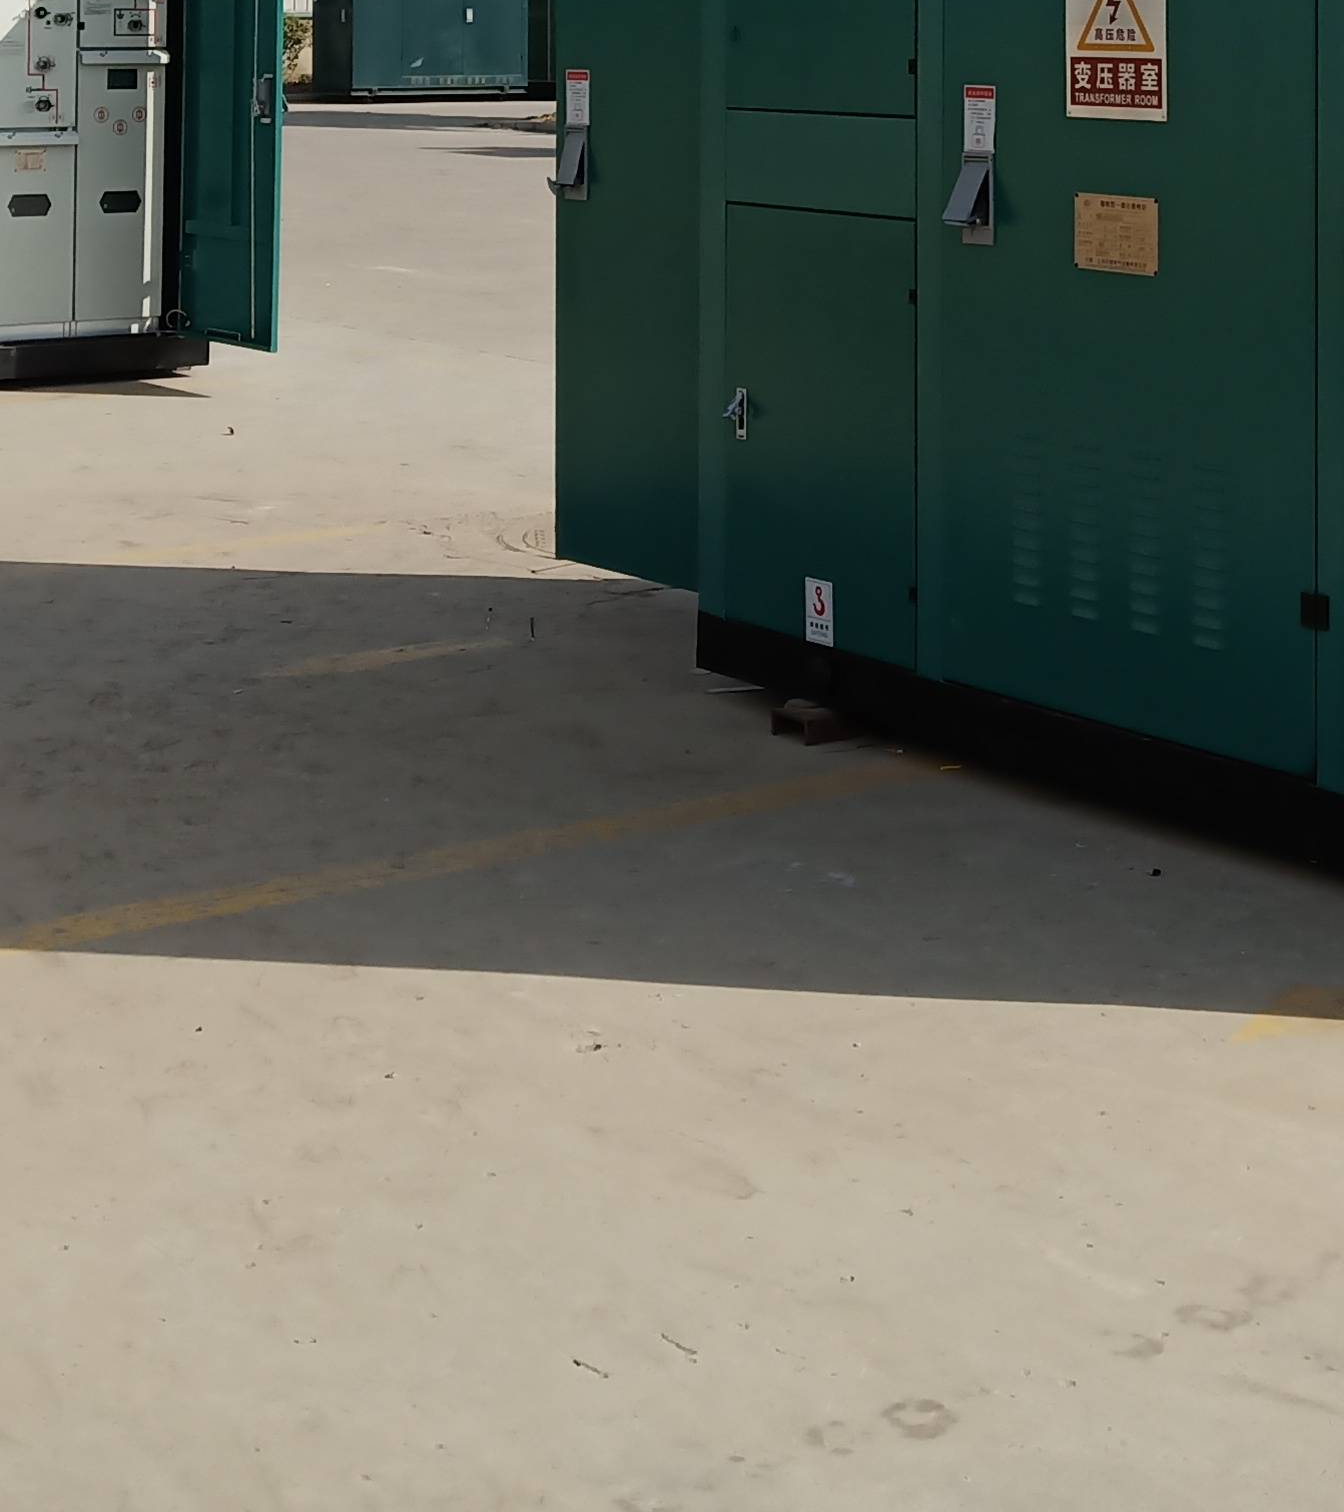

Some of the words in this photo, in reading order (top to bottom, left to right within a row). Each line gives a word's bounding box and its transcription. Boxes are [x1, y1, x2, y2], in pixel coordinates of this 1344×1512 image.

[1094, 28, 1137, 42] 高压危险
[1074, 60, 1159, 91] 变压器室
[1075, 92, 1133, 105] TRANSFORMER
[1134, 94, 1158, 106] ROOM
